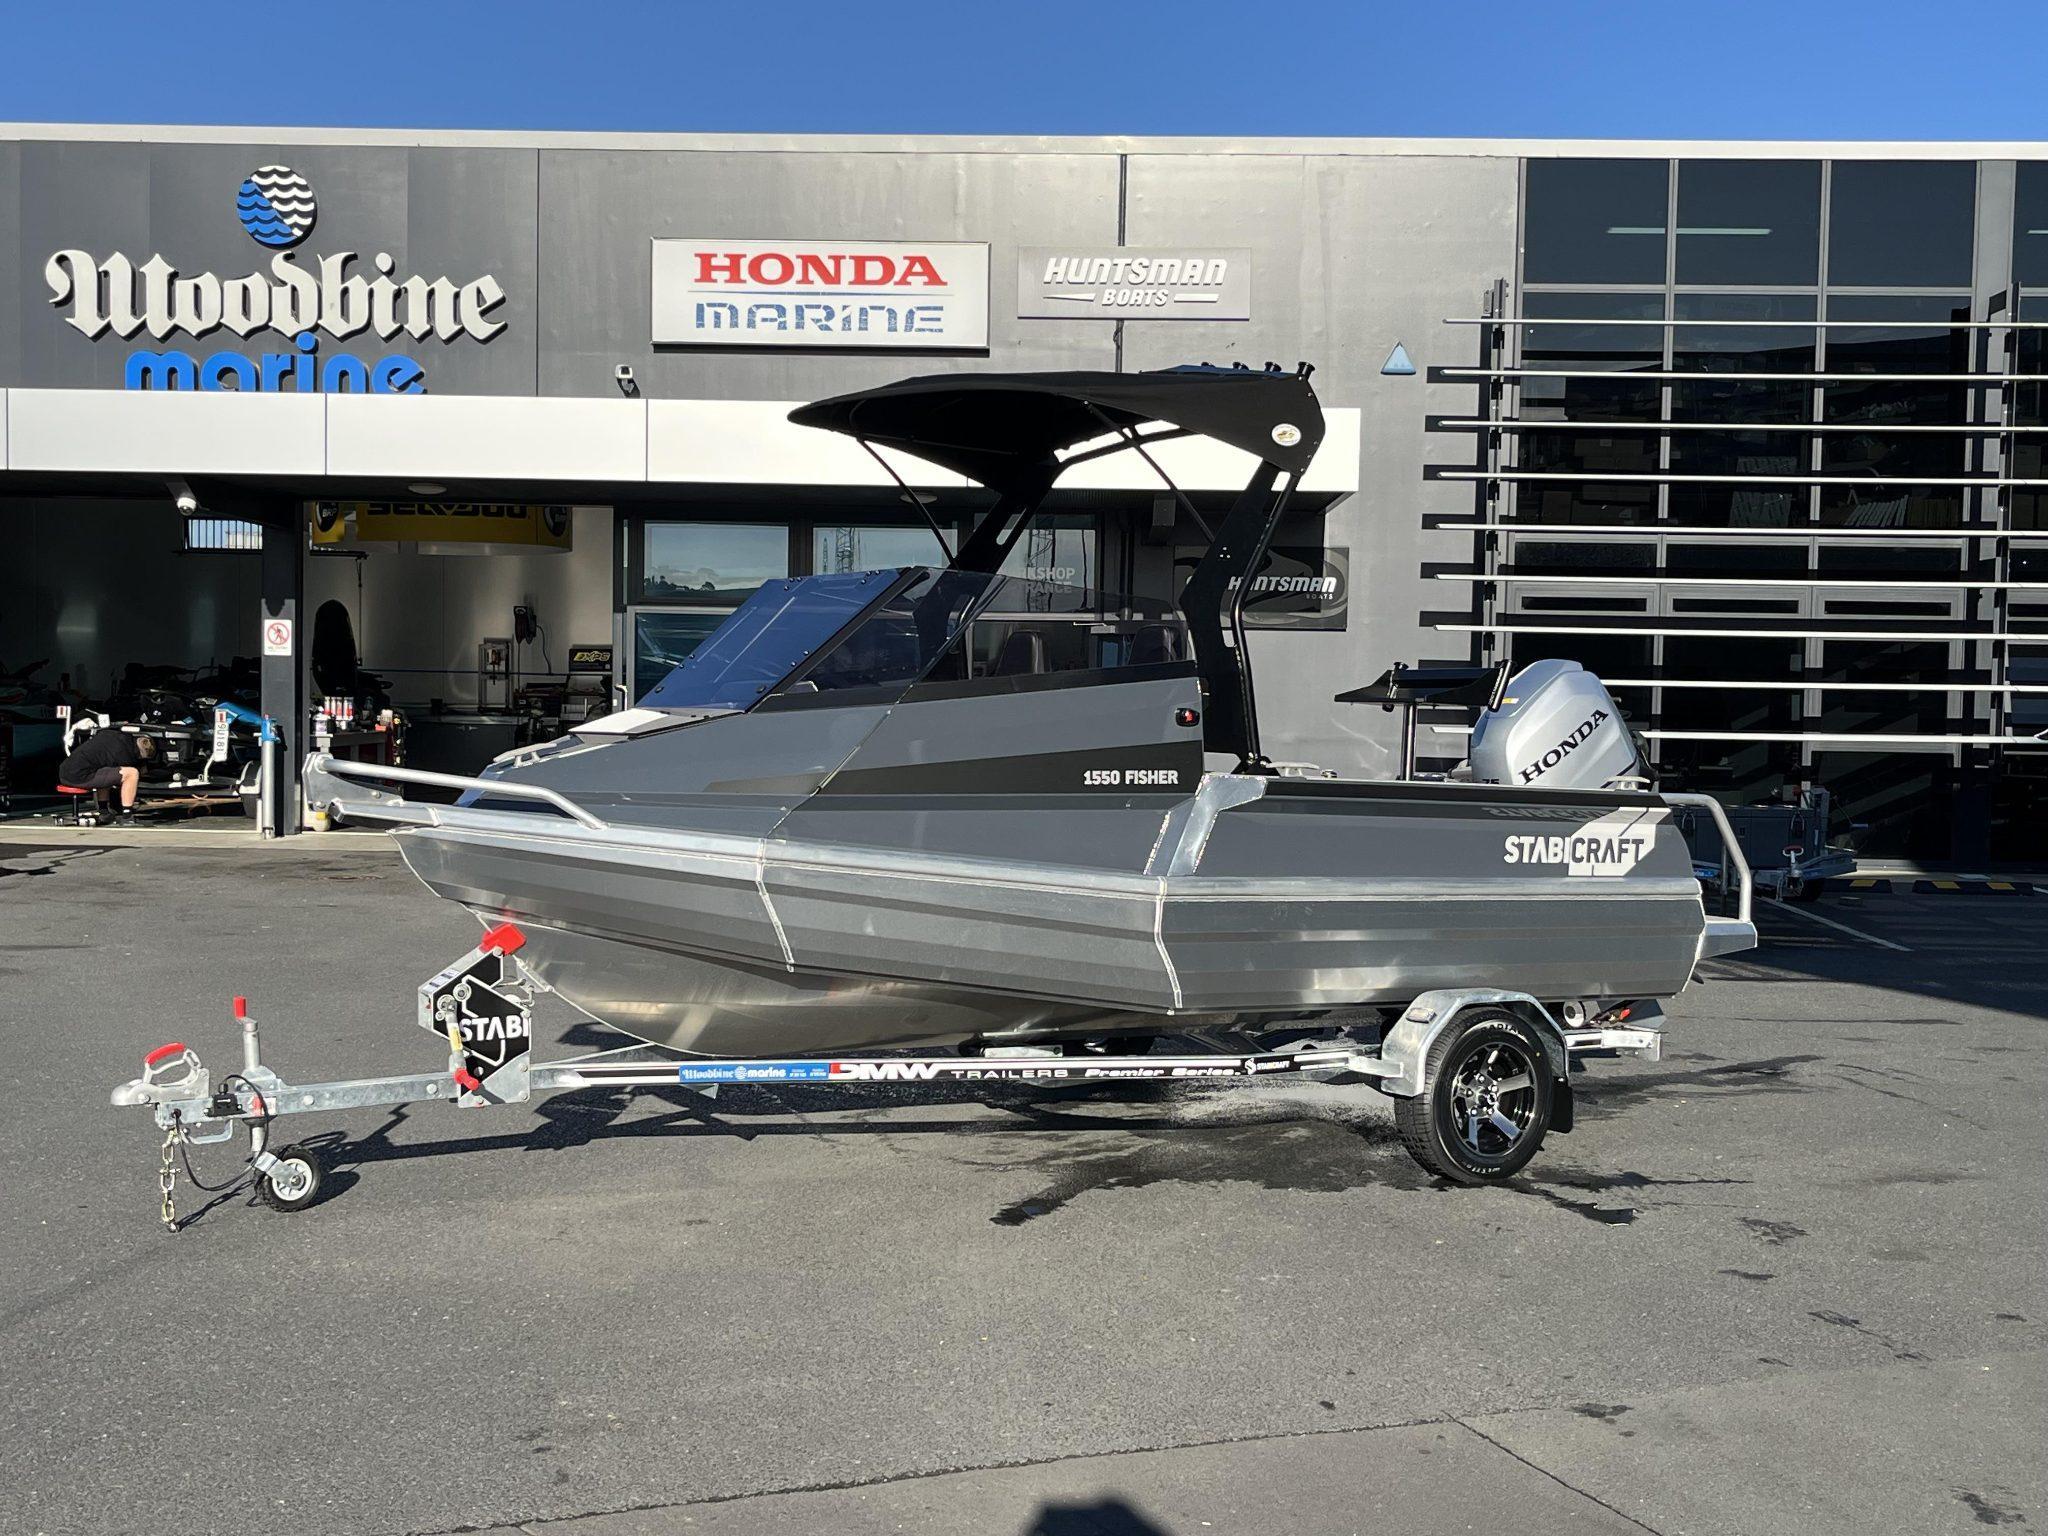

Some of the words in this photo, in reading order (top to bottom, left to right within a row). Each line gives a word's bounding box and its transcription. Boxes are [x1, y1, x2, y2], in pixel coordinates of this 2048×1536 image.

[694, 253, 948, 286] HONDA
[1043, 257, 1228, 285] HUNTSMAN
[45, 249, 507, 340] Woodbine
[1102, 289, 1169, 306] BOATS
[696, 302, 944, 333] MARINE
[125, 331, 424, 394] marine
[1228, 576, 1337, 593] HNTSMAN
[1519, 709, 1609, 785] HONDA
[1083, 769, 1120, 785] 1550
[1125, 769, 1179, 785] FISHER
[1503, 835, 1645, 865] STABICRAFT
[748, 1066, 787, 1078] marine
[830, 1062, 945, 1080] DMW
[951, 1069, 1069, 1079] TRAILERS
[1085, 1068, 1164, 1078] Premier
